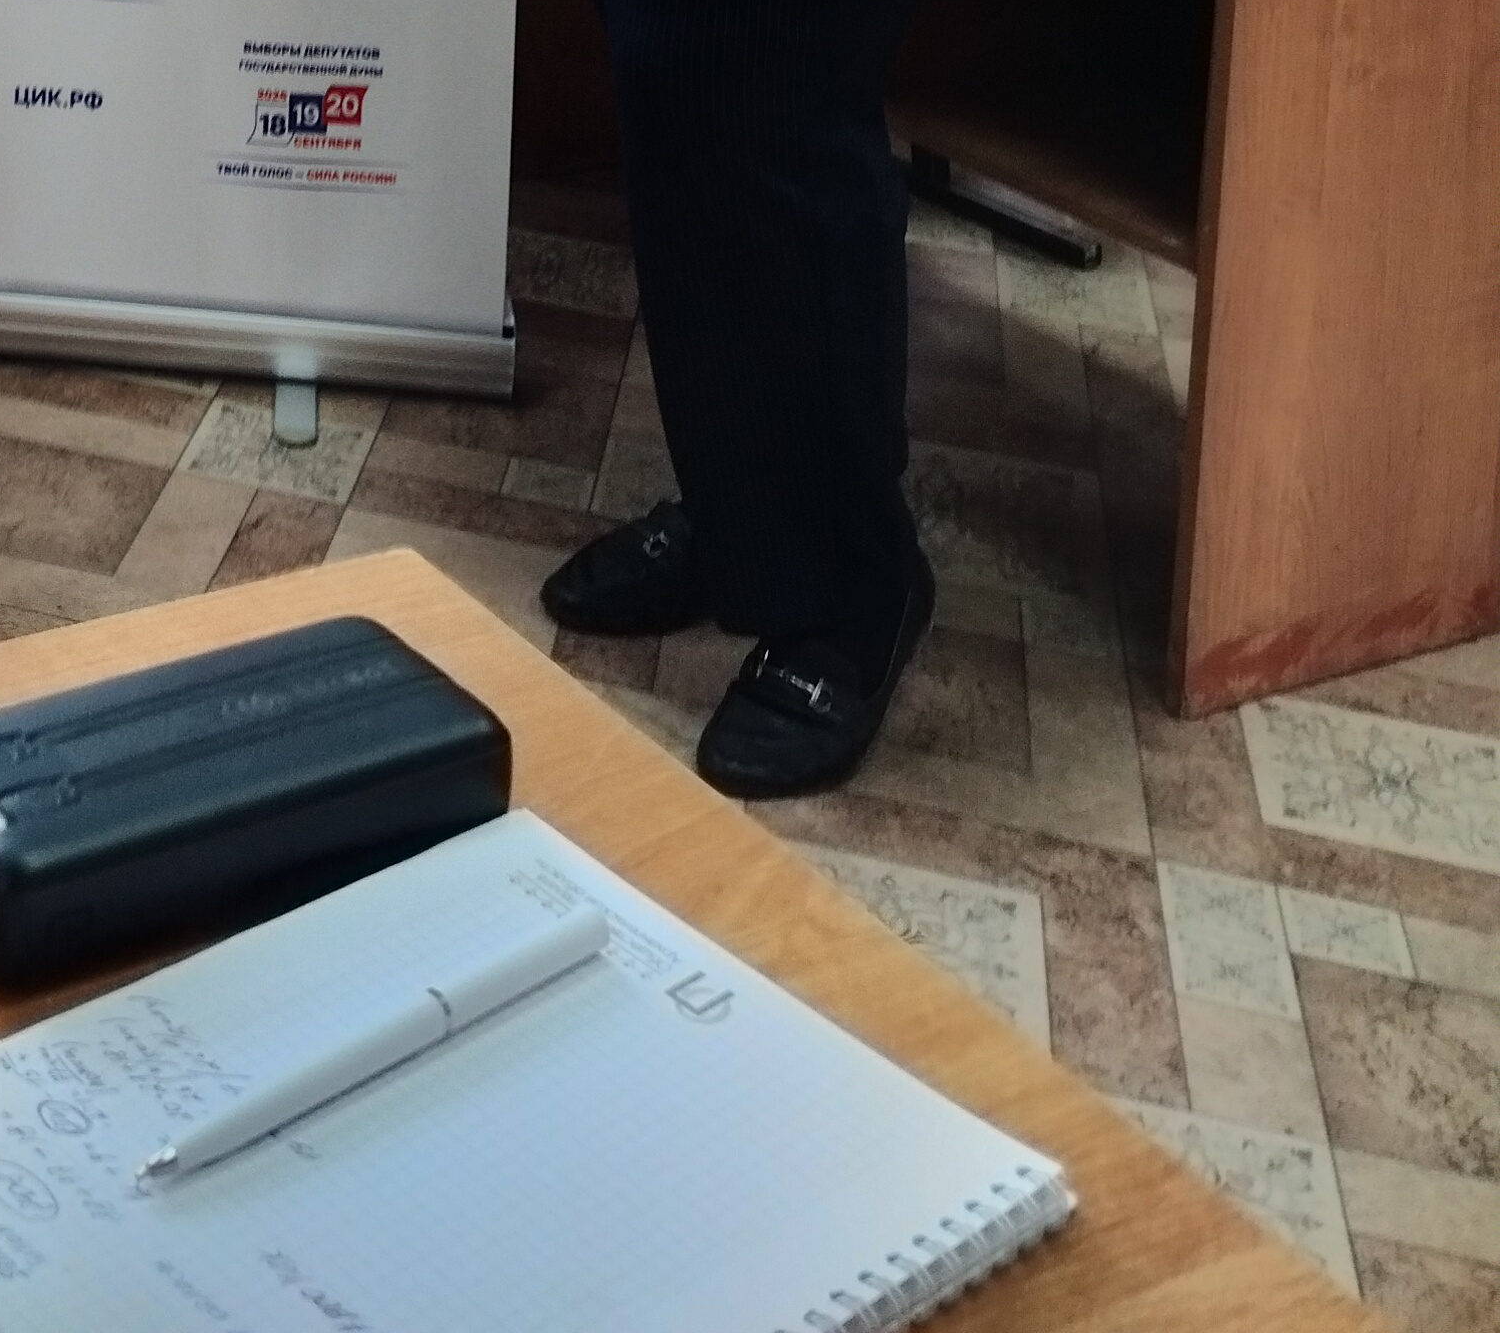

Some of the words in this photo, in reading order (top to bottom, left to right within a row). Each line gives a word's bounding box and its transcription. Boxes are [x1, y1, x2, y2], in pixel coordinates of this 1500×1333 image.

[14, 87, 103, 111] ЦИК.РФ
[293, 103, 319, 126] 19
[327, 93, 358, 117] 20
